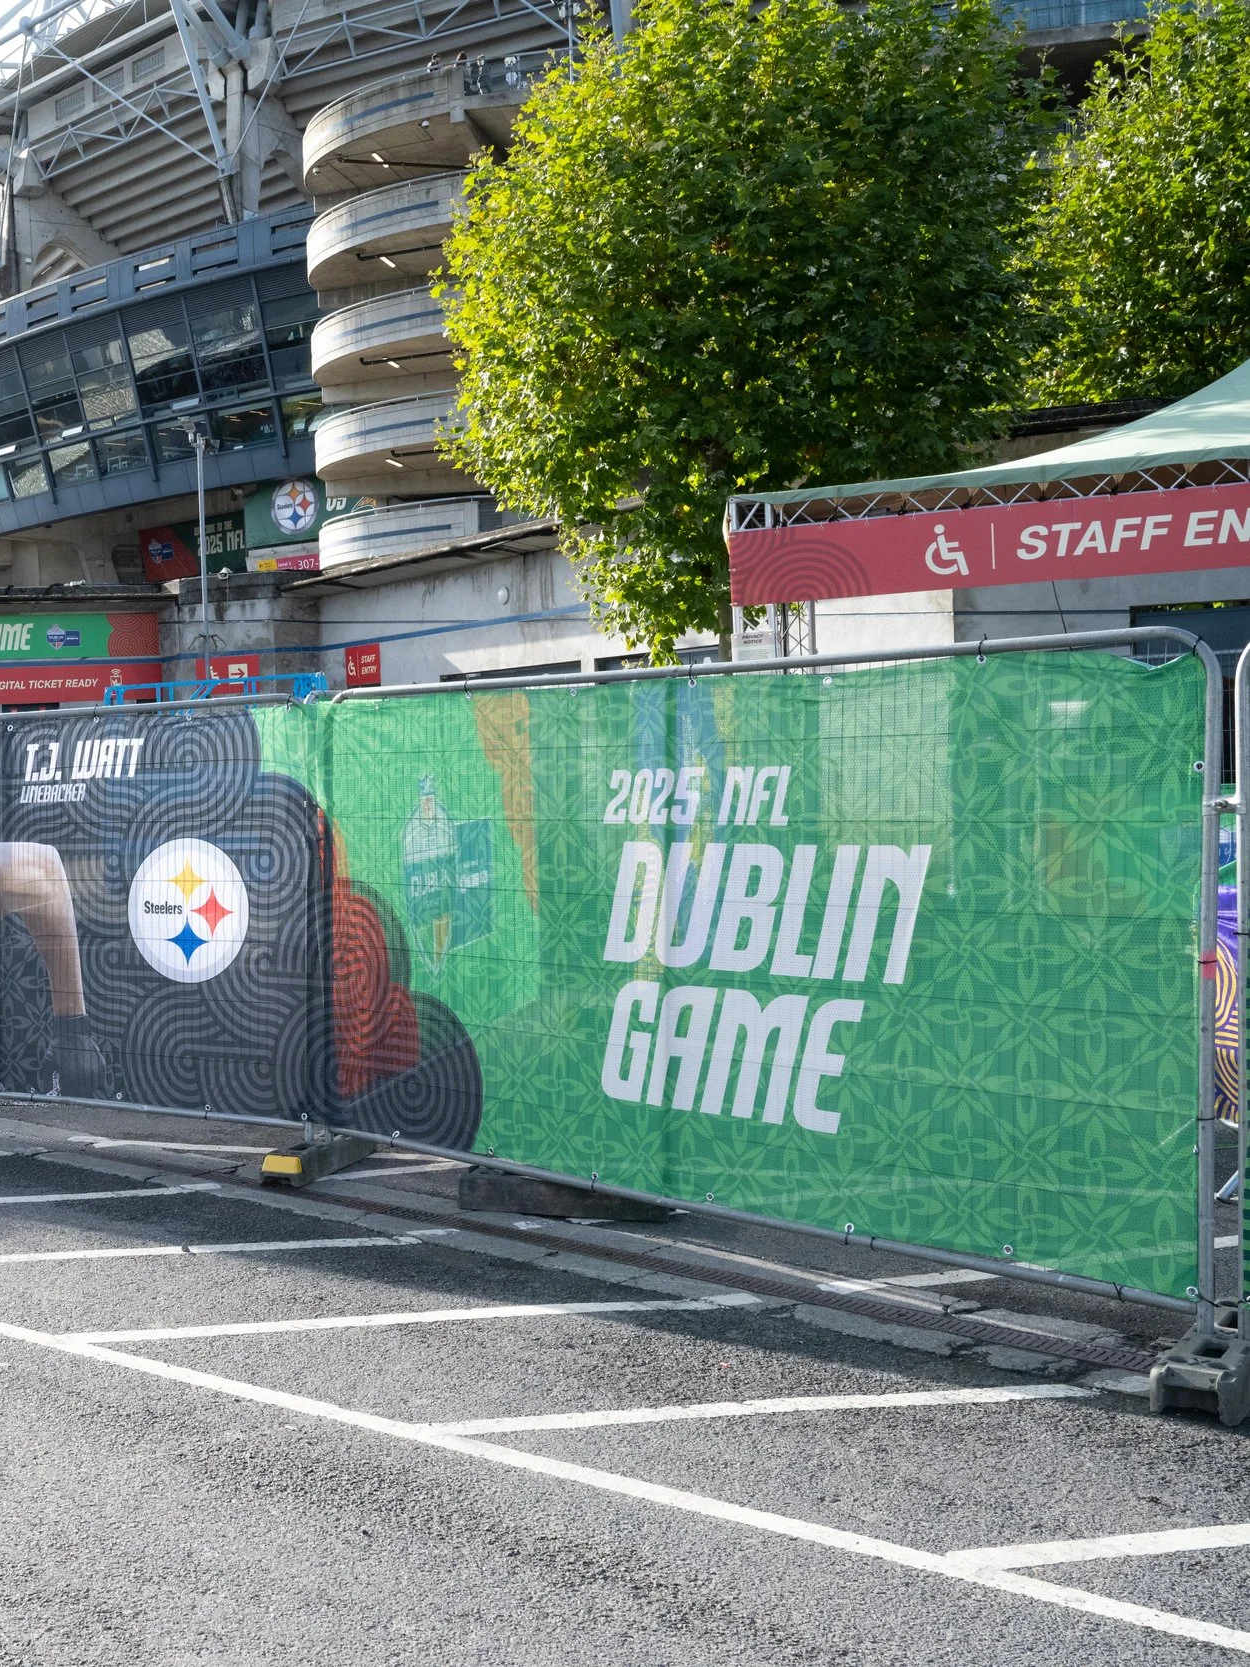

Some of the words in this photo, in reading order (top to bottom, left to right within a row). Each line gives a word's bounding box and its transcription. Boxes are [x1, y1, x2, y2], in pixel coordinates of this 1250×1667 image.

[227, 529, 245, 551] NFL
[1016, 514, 1173, 560] STAFF
[1183, 508, 1250, 547] EN
[360, 654, 376, 664] STAFF
[361, 665, 377, 675] ENTRY
[28, 679, 63, 689] TICKET
[65, 678, 99, 688] READY
[24, 742, 62, 782] T.J.
[71, 738, 145, 780] WATT
[20, 783, 86, 804] LINEBACKER
[603, 766, 705, 825] 2025
[717, 765, 791, 827] NFL
[144, 900, 183, 915] Steelers
[603, 841, 933, 985] DUBLIN
[601, 979, 865, 1135] GAME
